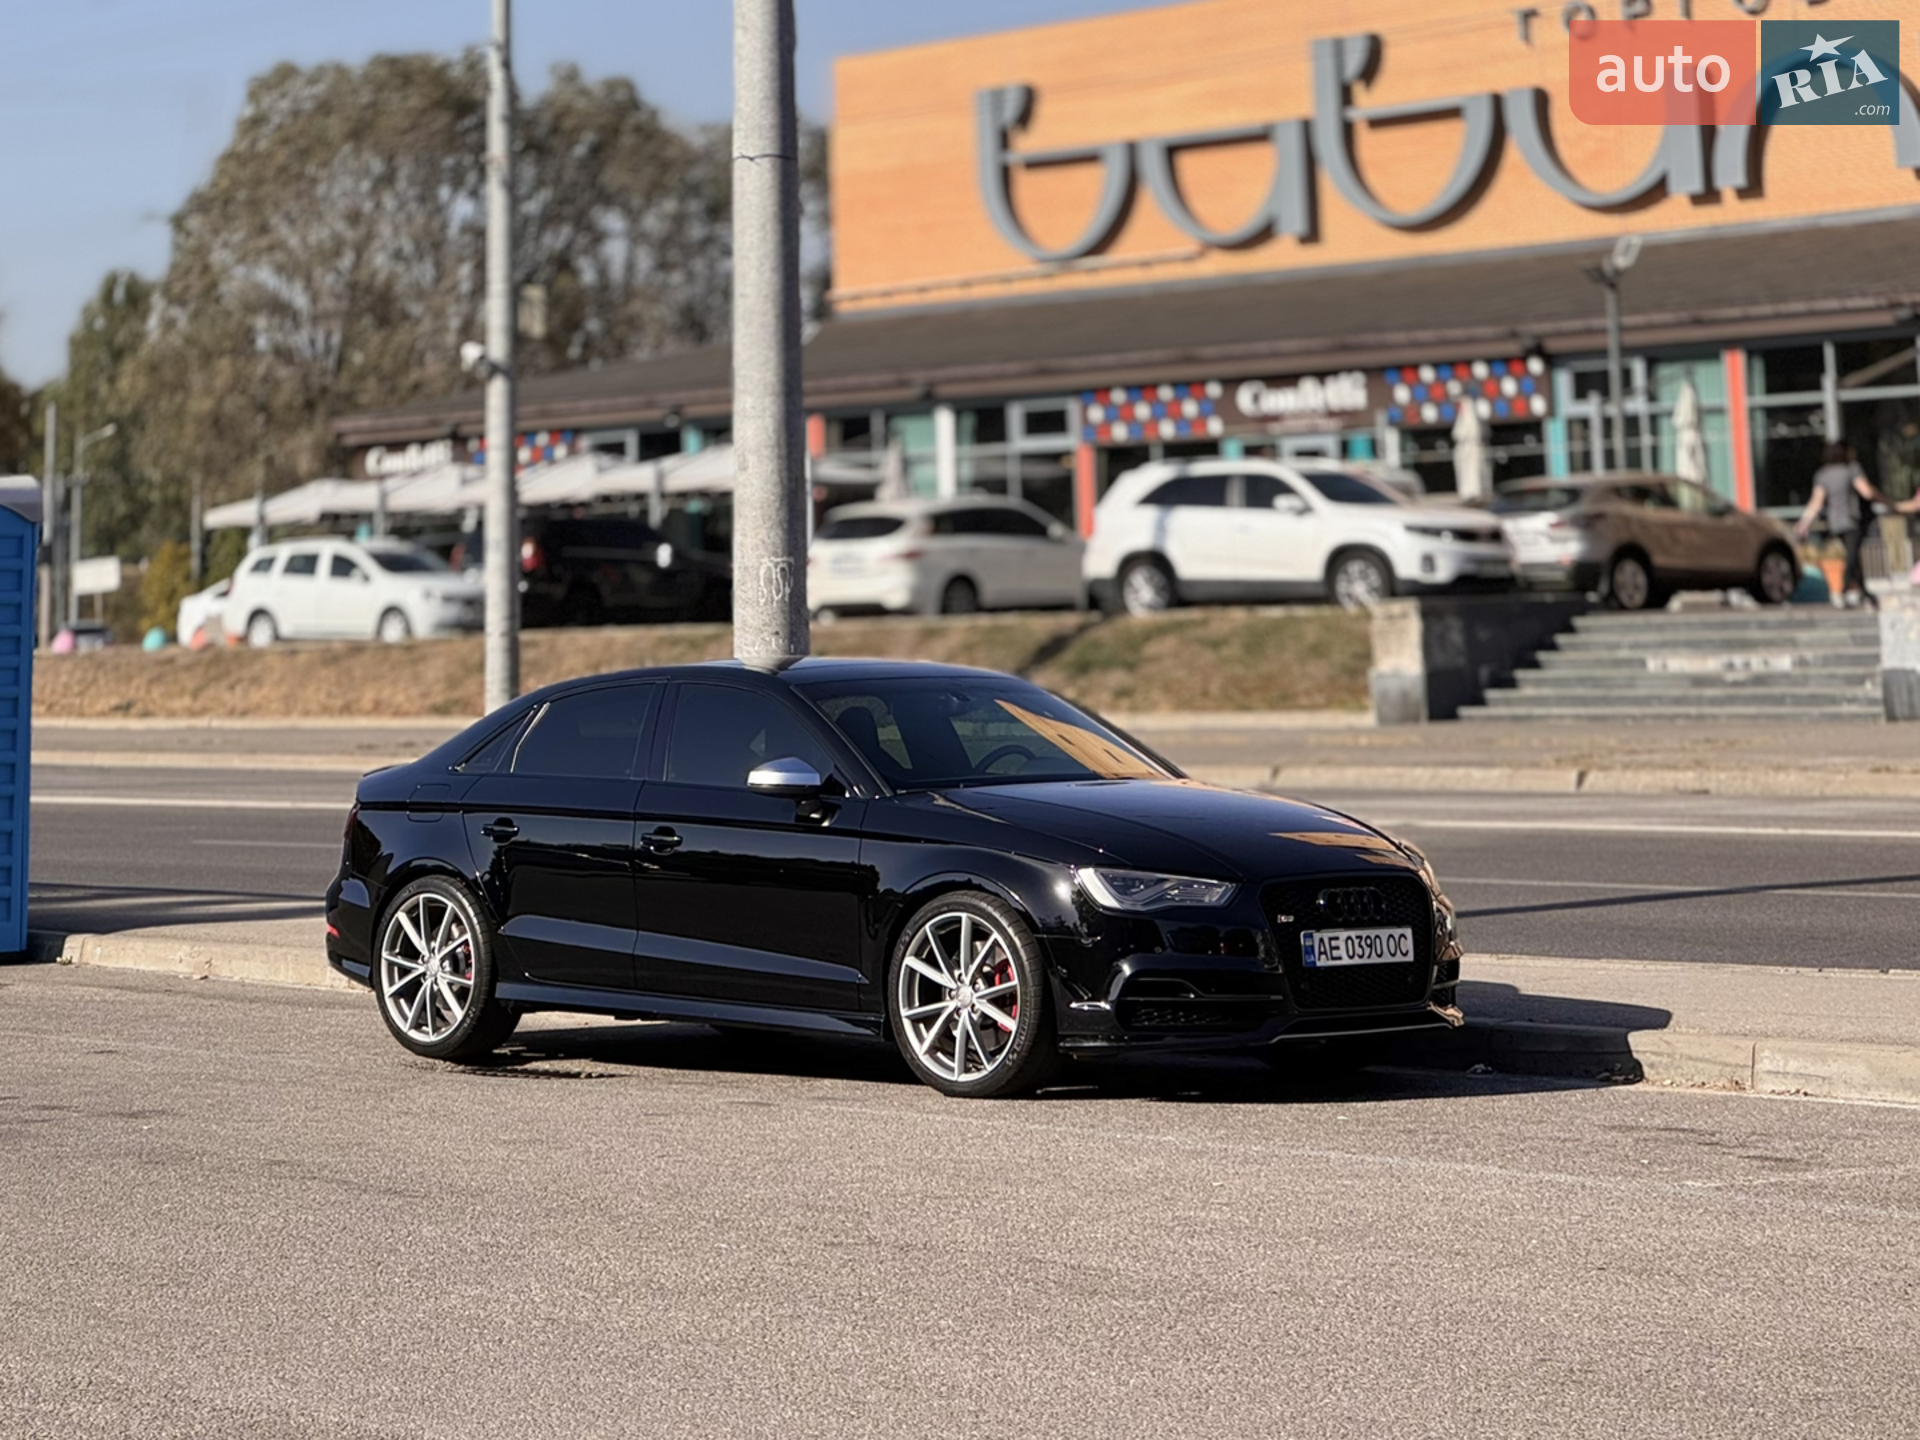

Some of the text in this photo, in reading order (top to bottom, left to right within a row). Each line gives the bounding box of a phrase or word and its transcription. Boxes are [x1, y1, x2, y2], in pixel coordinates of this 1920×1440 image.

[1317, 933, 1409, 962] AE 0390 OC
